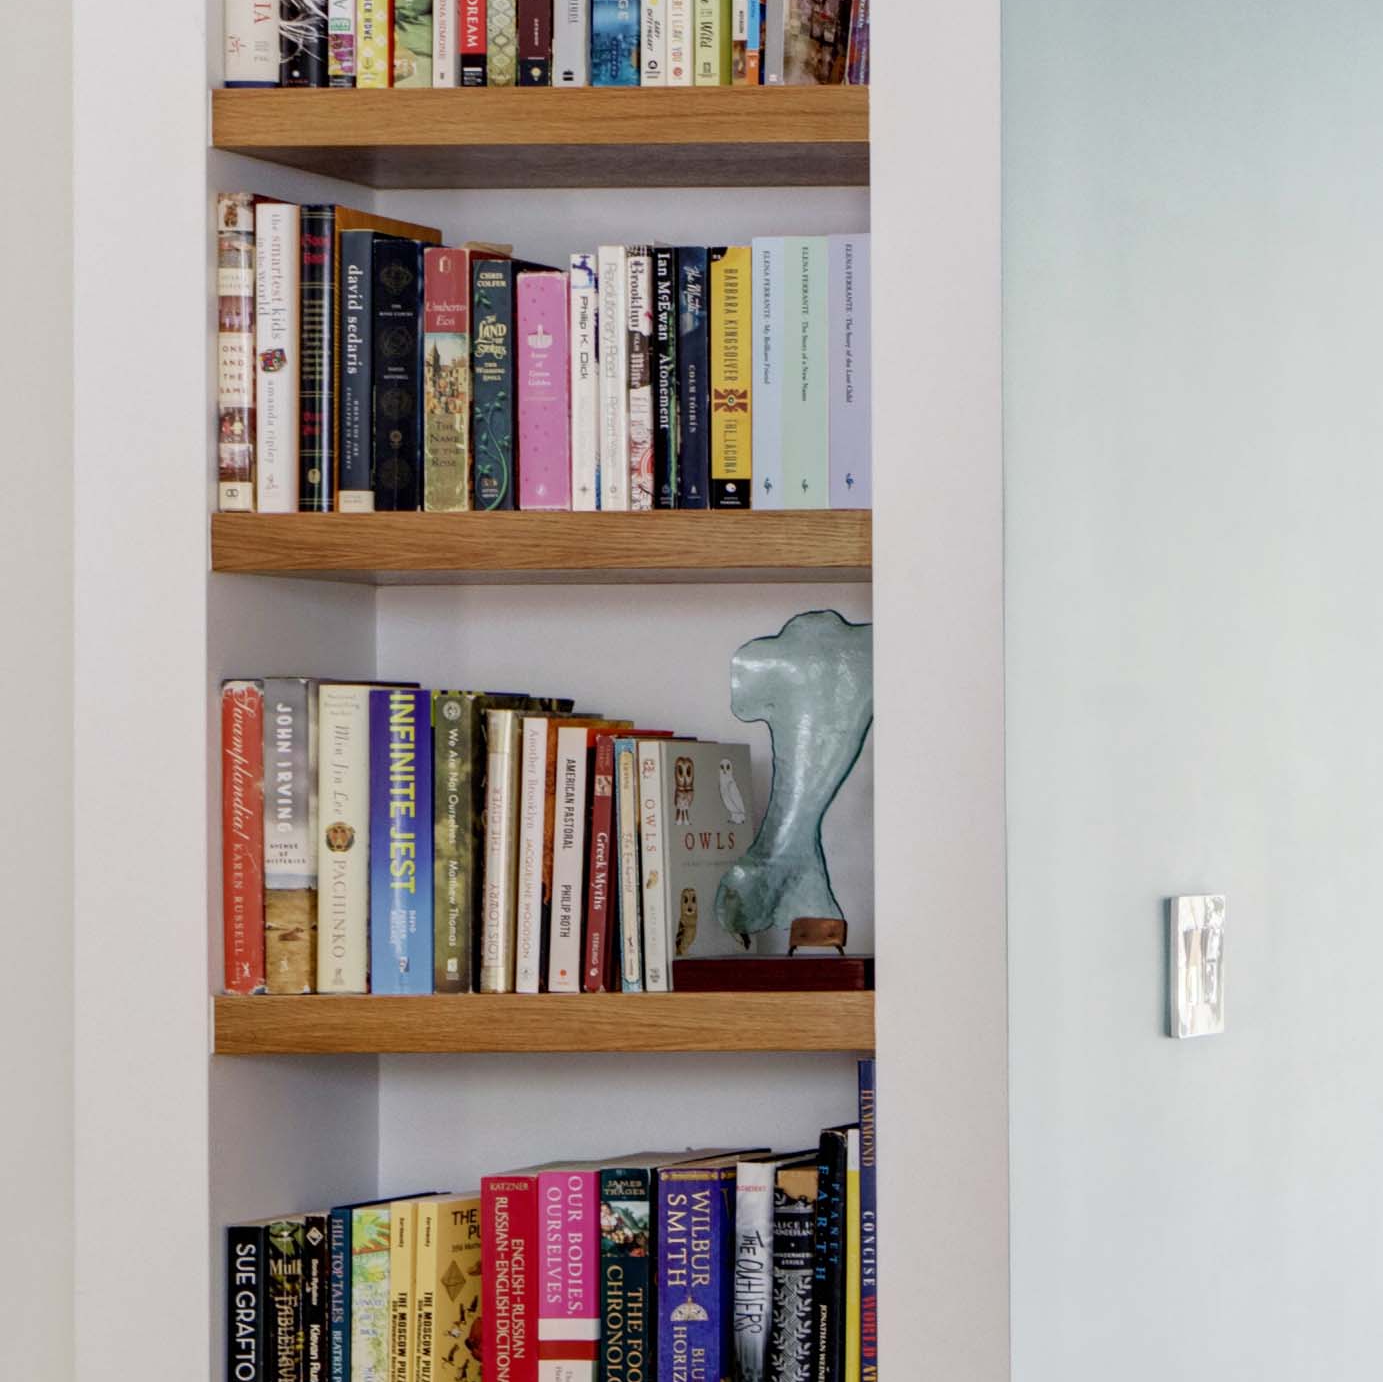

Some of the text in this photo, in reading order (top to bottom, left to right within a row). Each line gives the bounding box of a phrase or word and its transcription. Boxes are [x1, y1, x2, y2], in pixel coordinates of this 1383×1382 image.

[657, 253, 671, 276] Ian
[347, 264, 363, 375] david sedaris
[724, 268, 738, 382] BARBARA KINGSOLVER
[659, 353, 673, 429] Atonement
[225, 689, 256, 839] Swamplandia!
[276, 703, 293, 833] JOHN IRVING
[389, 693, 415, 894] INFINITE JEST
[562, 758, 577, 850] AMERICAN PASTORAL
[559, 884, 572, 938] PHILIP ROTH
[860, 1089, 876, 1167] HAMMOND
[234, 1243, 256, 1285] SUE
[545, 1186, 562, 1304] OURSELVES
[566, 1176, 584, 1315] OUR BODIES,
[666, 1194, 686, 1288] SMITH
[690, 1191, 710, 1288] WILBUR
[861, 1211, 877, 1288] CONCISE
[626, 1288, 643, 1334] THE
[862, 1296, 878, 1358] WORLD
